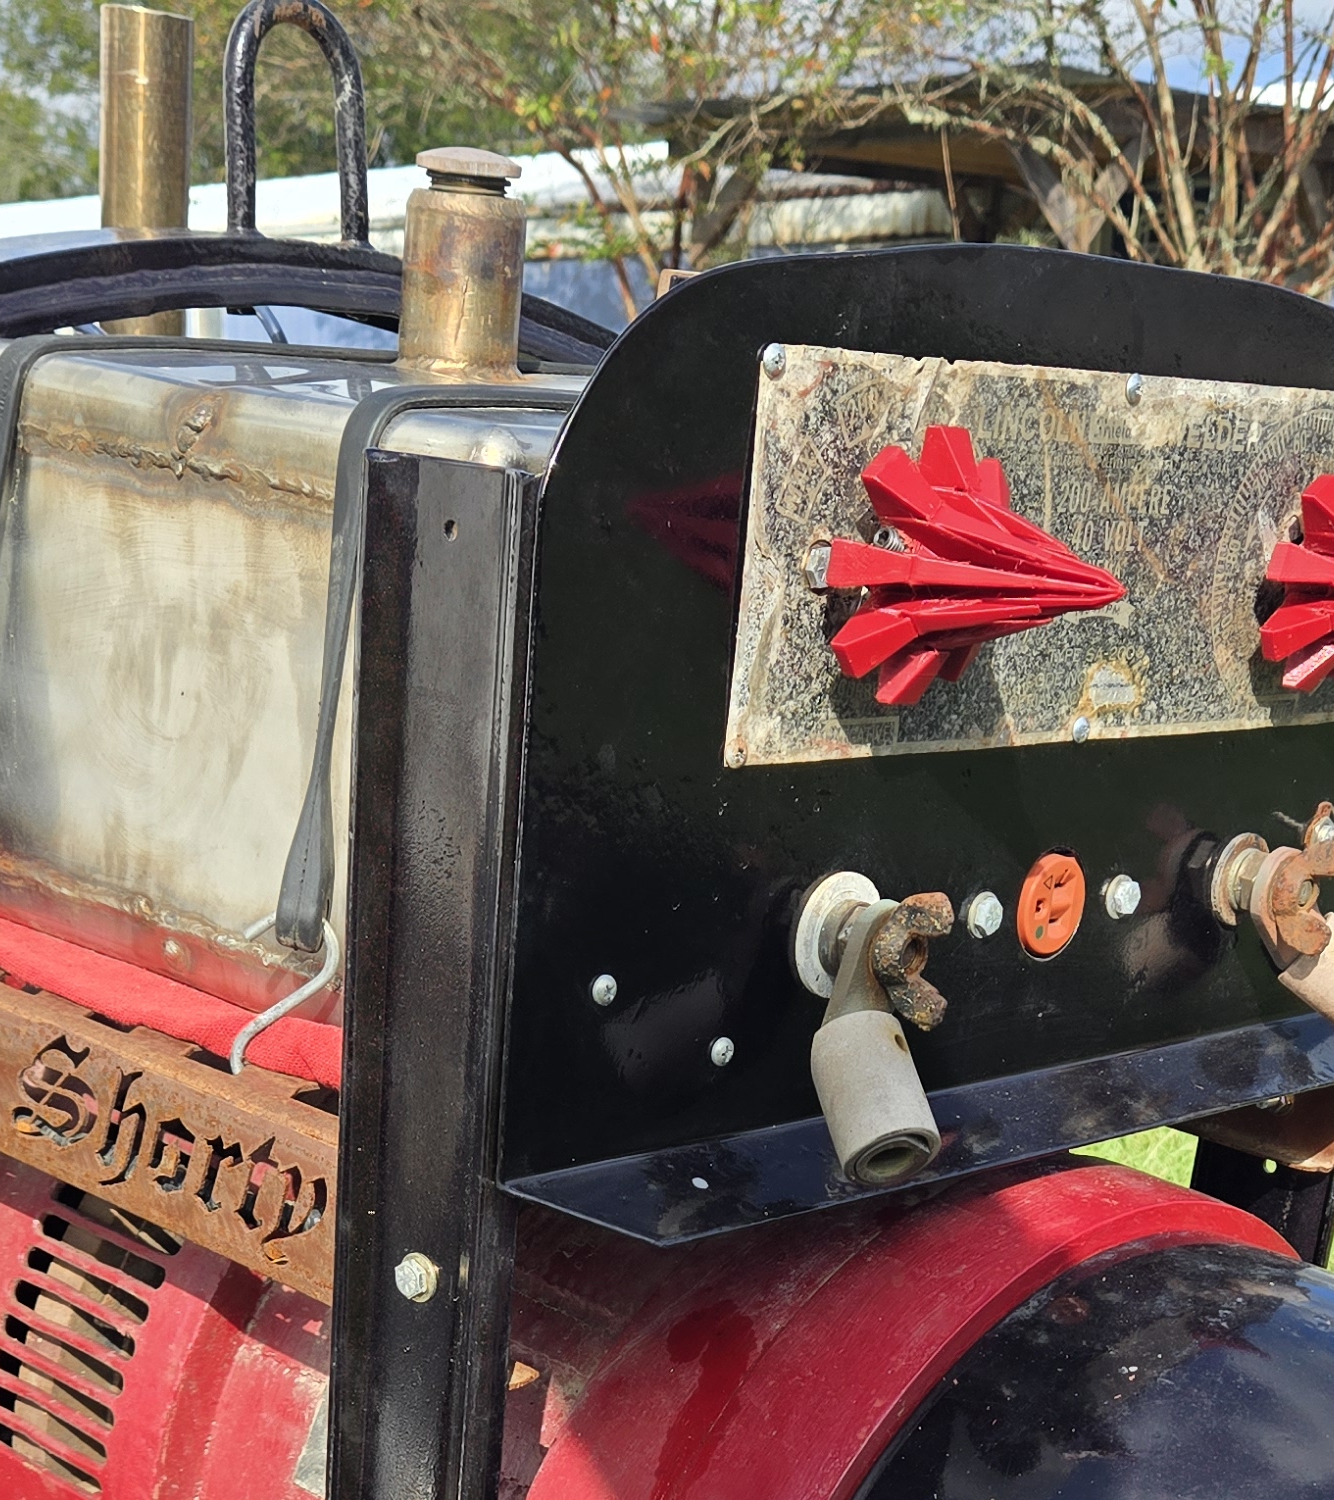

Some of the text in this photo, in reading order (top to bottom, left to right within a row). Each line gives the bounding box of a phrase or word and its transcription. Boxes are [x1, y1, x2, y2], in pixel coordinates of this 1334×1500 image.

[977, 404, 1087, 442] LINCOLN
[1056, 481, 1173, 516] 200 AMPERE
[1104, 518, 1150, 552] VOLT
[11, 1035, 328, 1266] Shorty
